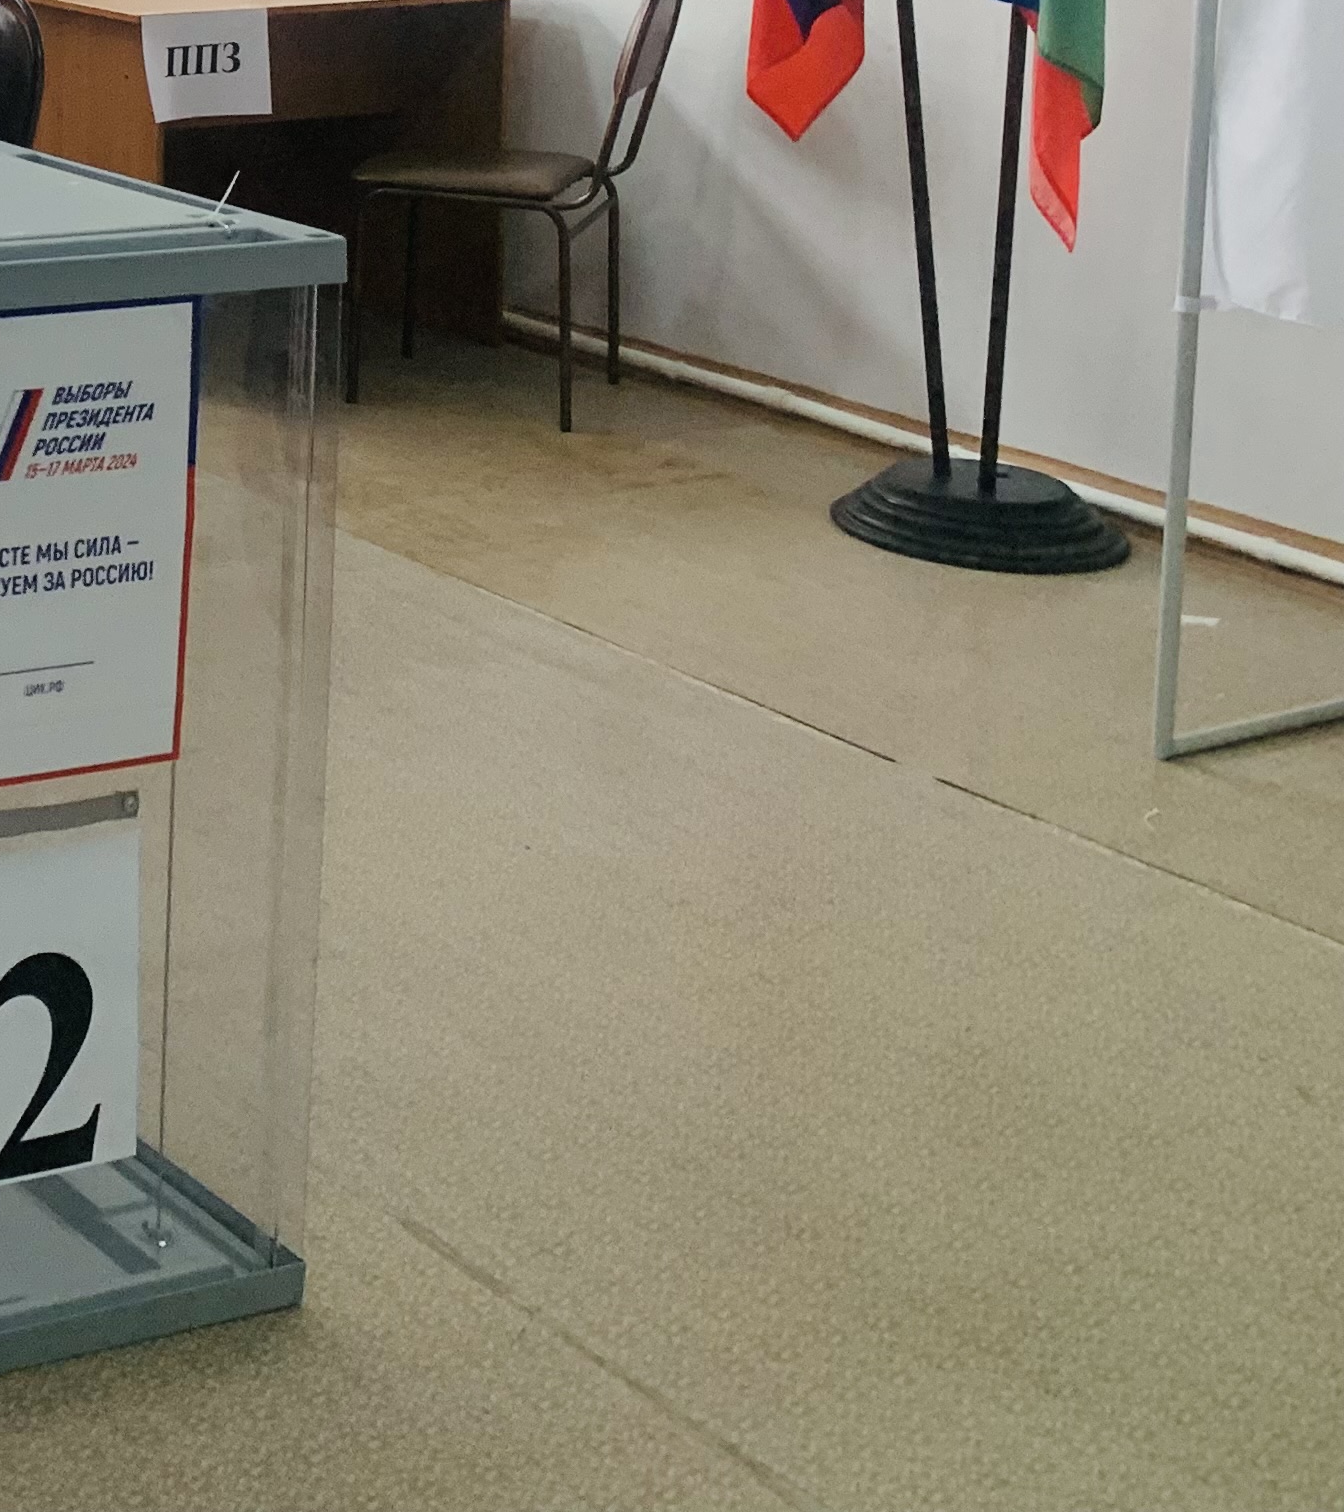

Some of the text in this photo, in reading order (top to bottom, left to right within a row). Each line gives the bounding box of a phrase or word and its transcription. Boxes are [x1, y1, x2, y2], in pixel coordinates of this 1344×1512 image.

[52, 380, 133, 405] ВЫБОРЫ
[42, 402, 155, 431] ПРЕЗИДЕНТА
[32, 432, 106, 457] РОССИИ
[62, 456, 106, 475] МАРТА
[106, 453, 137, 471] 2024
[36, 541, 68, 564] МЫ
[74, 535, 122, 559] СИЛА
[42, 571, 66, 592] ЗА
[70, 560, 154, 588] РОССИЮ!
